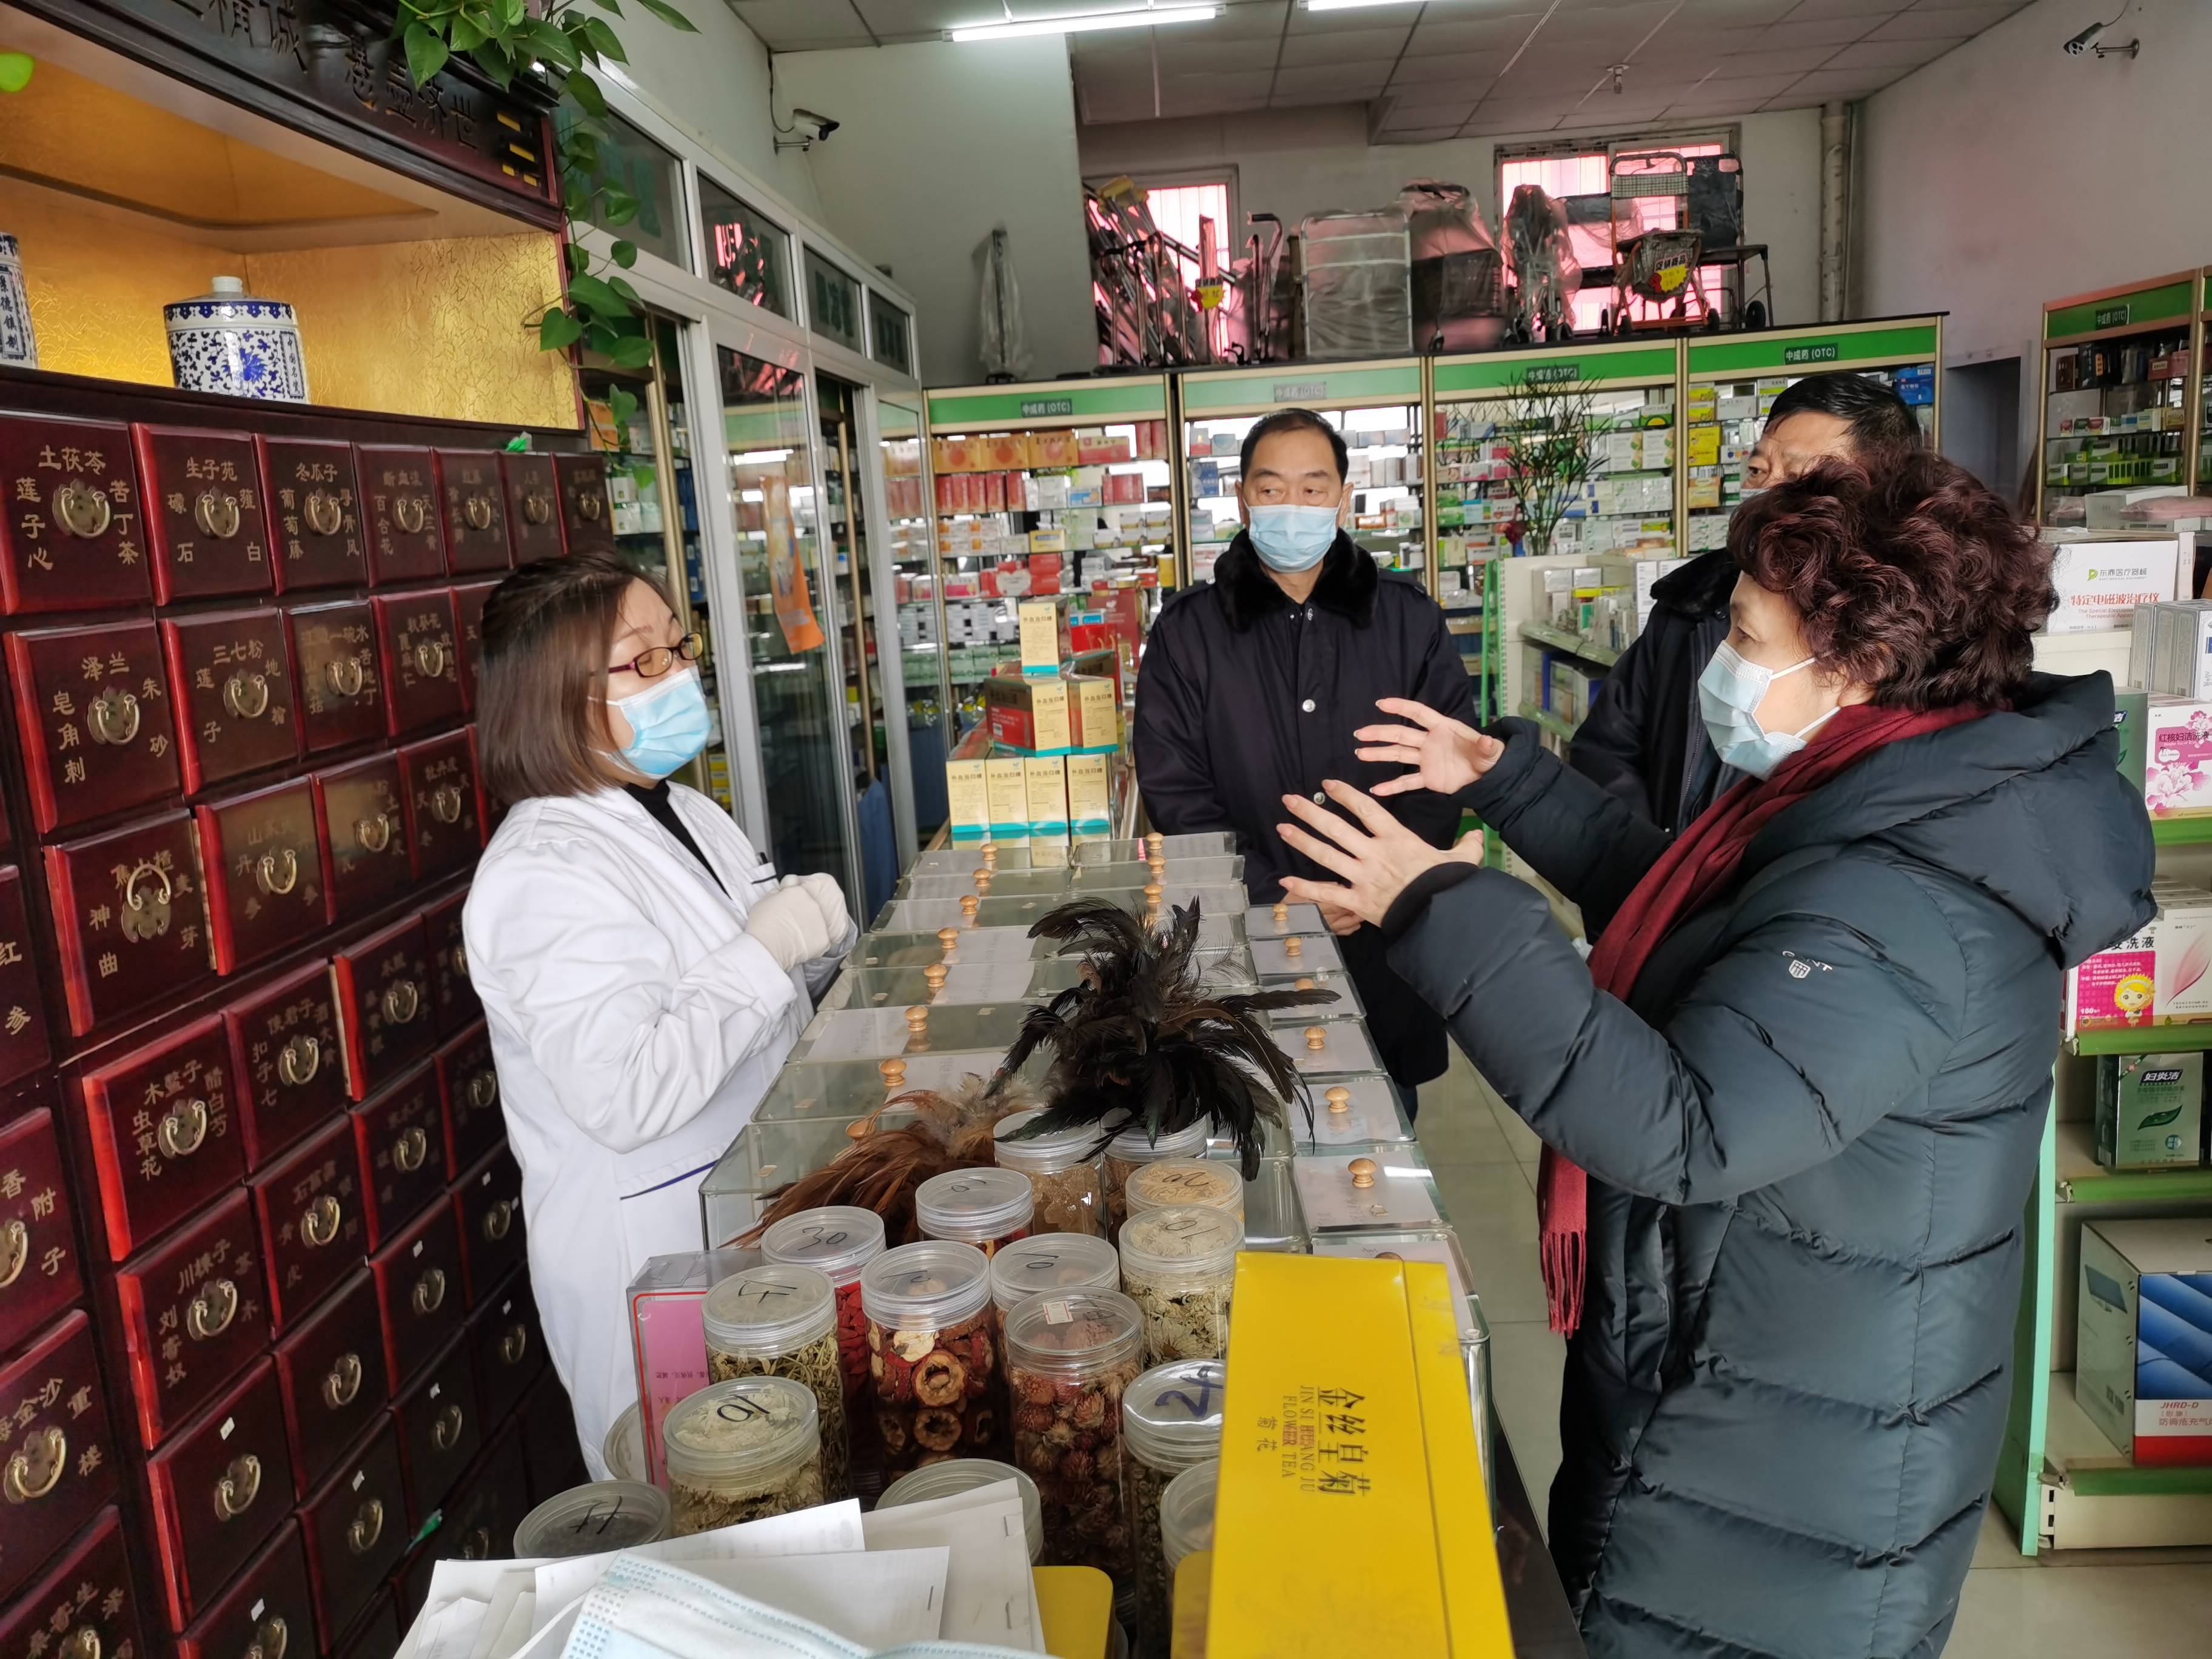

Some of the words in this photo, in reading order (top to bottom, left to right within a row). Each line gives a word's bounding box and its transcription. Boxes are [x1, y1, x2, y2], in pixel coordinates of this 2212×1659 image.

[1786, 350, 1809, 361] 中成药
[1811, 347, 1835, 360] (OTC)
[1299, 384, 1325, 398] (OTC)
[1047, 401, 1071, 414] (OTC)
[38, 444, 107, 475] 土茯苓
[295, 463, 338, 483] 冬瓜子
[16, 476, 54, 571] 莲子心
[109, 480, 139, 565] 苦丁茶
[279, 489, 304, 561] 葡萄藤
[374, 494, 394, 555] 百合花
[2099, 568, 2148, 577] 东鼎医疗器械
[2070, 592, 2160, 606] 特定电磁波治疗仪
[81, 651, 130, 681] 泽兰
[213, 640, 265, 665] 三七粉
[141, 677, 169, 758] 朱砂
[53, 691, 85, 785] 皂角刺
[2158, 730, 2210, 743] 红核妇洁洗液
[175, 872, 198, 951] 麦芽
[89, 904, 119, 979] 神曲
[2143, 1071, 2180, 1082] 妇炎洁
[132, 1108, 163, 1181] 虫草花
[802, 1226, 848, 1252] 30
[1299, 1384, 1315, 1405] JIN
[1282, 1395, 1298, 1446] FLOWER
[1299, 1407, 1315, 1423] SI
[1299, 1424, 1315, 1472] HUANG
[1317, 1386, 1371, 1496] 金丝皇菊
[1281, 1451, 1297, 1478] TEA
[1299, 1475, 1315, 1493] JU
